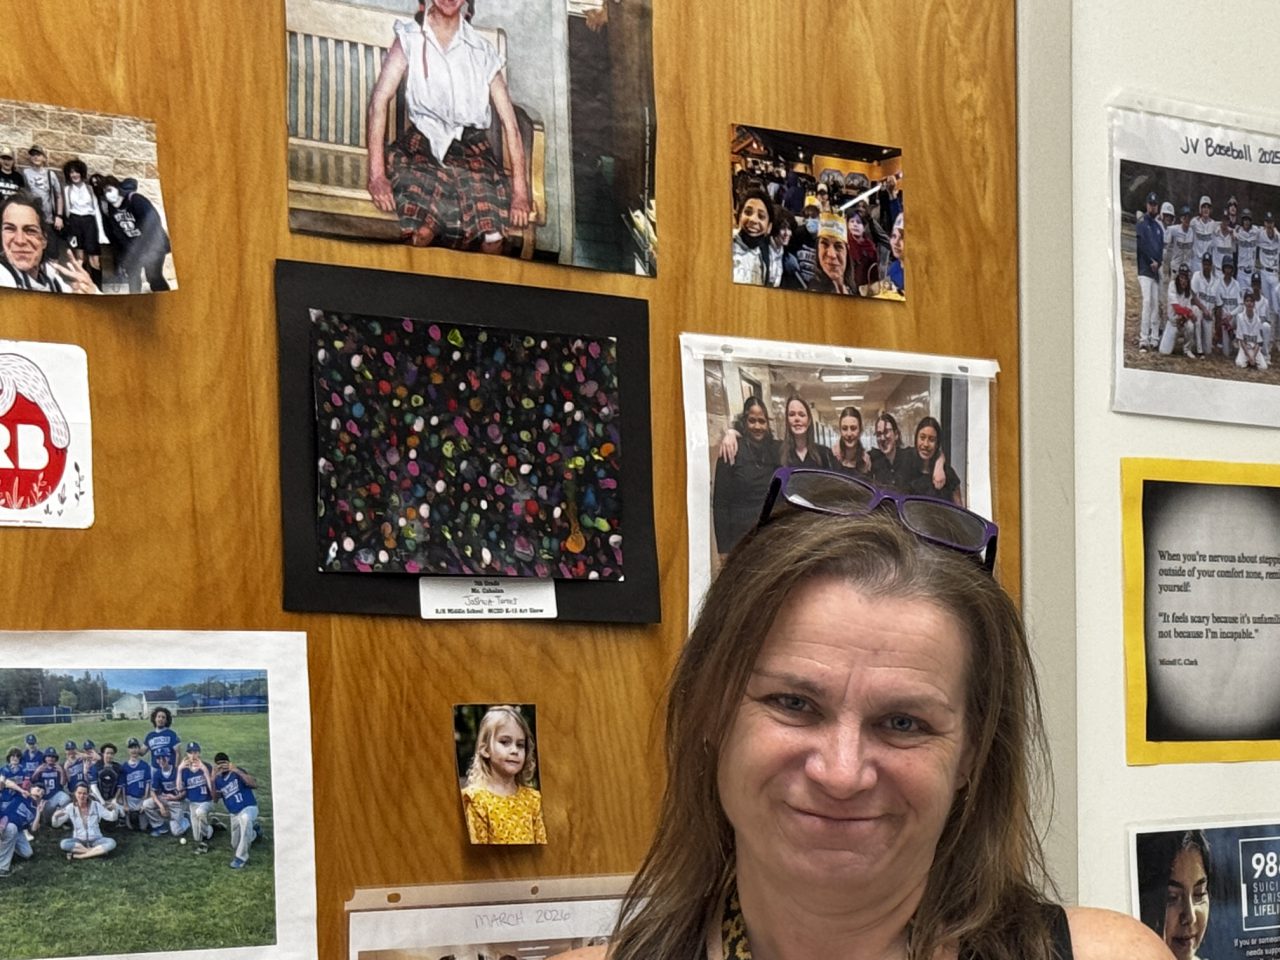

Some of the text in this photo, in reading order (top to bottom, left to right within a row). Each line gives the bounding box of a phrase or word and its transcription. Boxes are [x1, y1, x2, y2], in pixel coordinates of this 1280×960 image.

[1180, 136, 1199, 154] JV
[1205, 137, 1252, 162] Baseball
[1158, 550, 1181, 562] When
[1182, 551, 1207, 564] you're
[1208, 554, 1236, 563] nervous
[1237, 553, 1258, 564] about
[1158, 566, 1186, 577] outside
[1187, 566, 1196, 577] of
[1196, 569, 1215, 580] your
[1216, 567, 1244, 579] comfort
[1172, 612, 1189, 624] feels
[1190, 614, 1210, 626] scary
[1211, 613, 1239, 624] because
[1240, 613, 1251, 625] it's
[1158, 629, 1172, 639] not
[1174, 628, 1203, 639] because
[1205, 628, 1218, 639] I'm
[1254, 895, 1259, 905] &
[474, 911, 523, 929] MARCH
[1239, 938, 1250, 948] you
